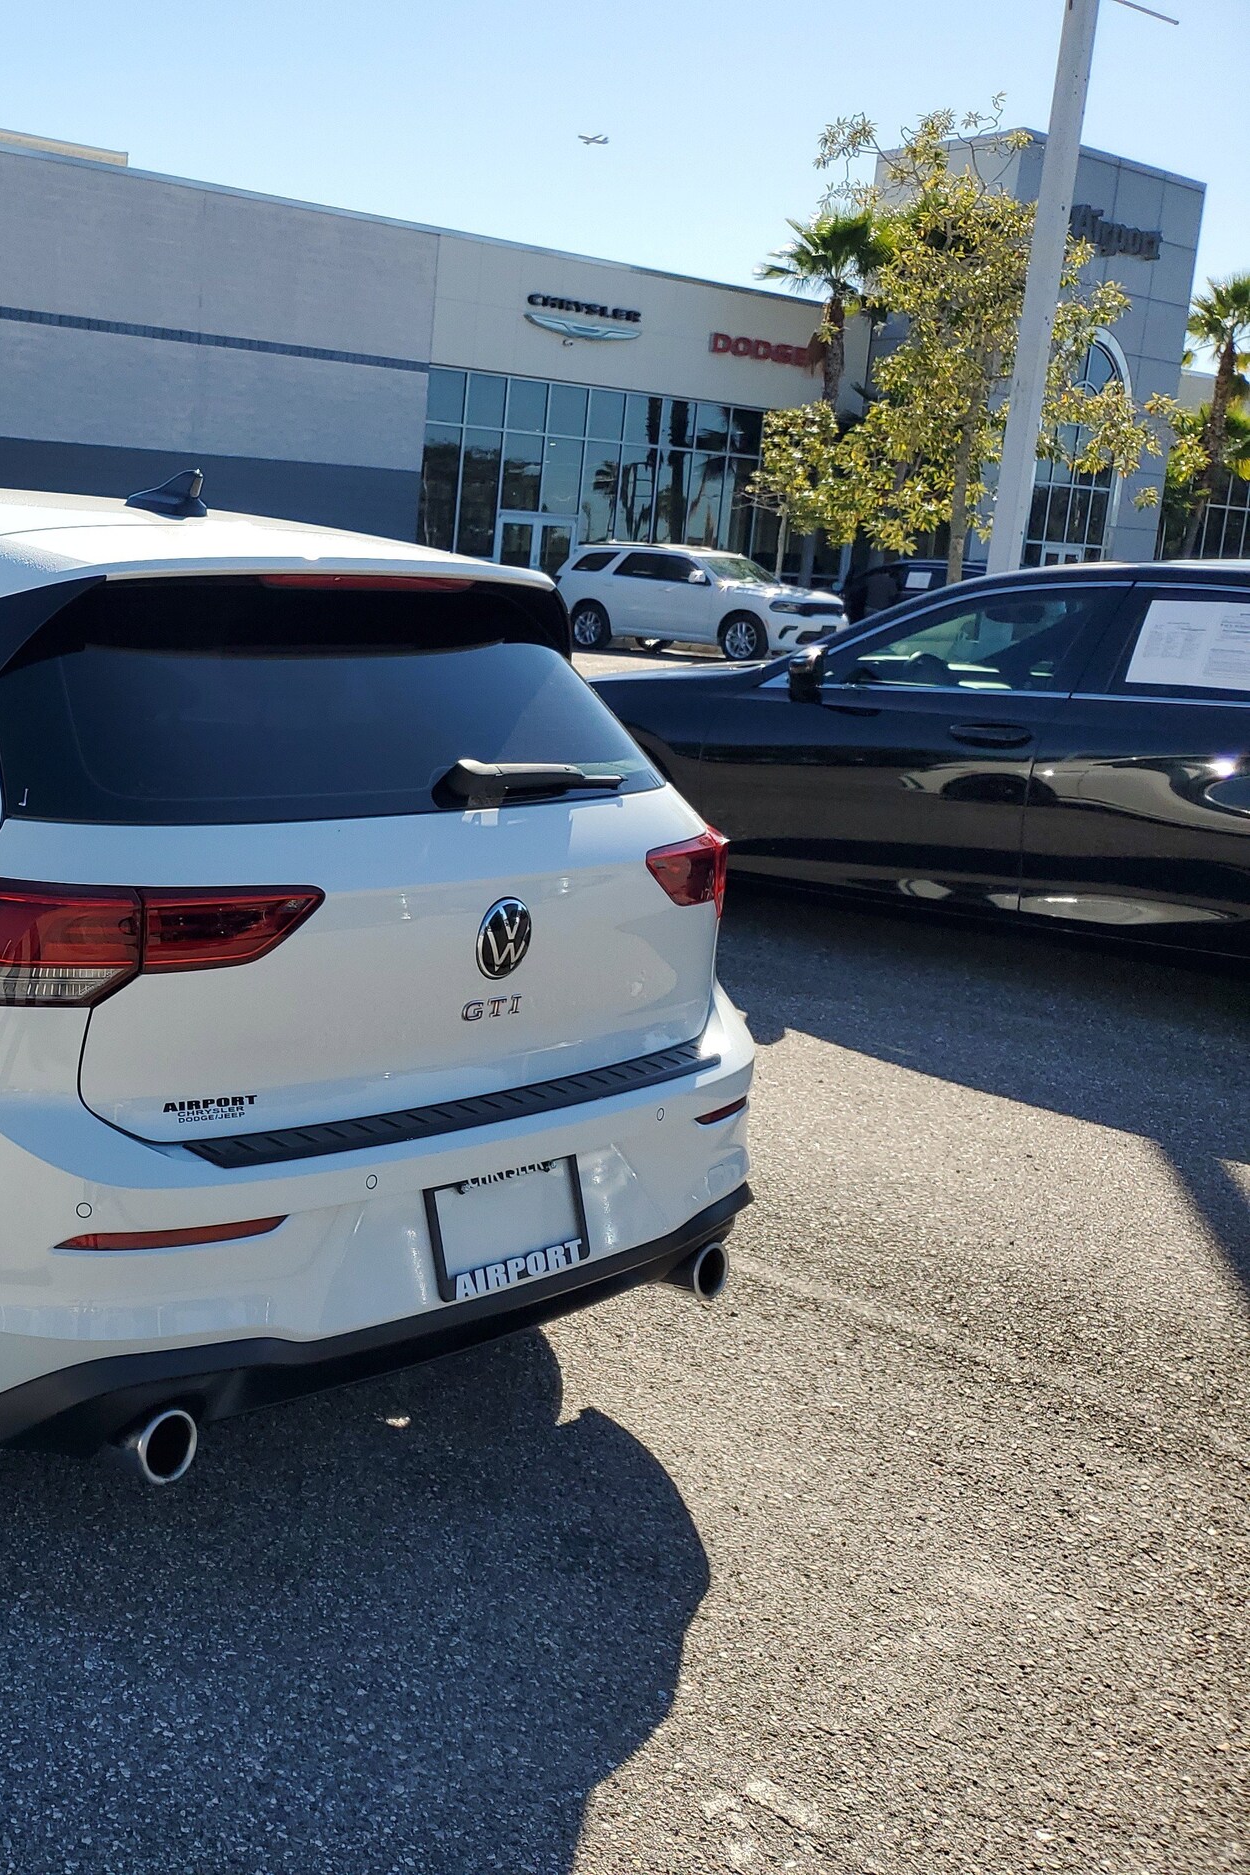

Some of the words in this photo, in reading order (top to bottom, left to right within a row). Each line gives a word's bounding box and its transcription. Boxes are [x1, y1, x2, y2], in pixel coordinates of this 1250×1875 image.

[527, 293, 642, 323] CHRYSLER
[709, 332, 811, 368] DODGE
[461, 993, 523, 1021] GTI
[162, 1094, 258, 1113] AIRPORT
[177, 1105, 245, 1118] CHRYSLER
[178, 1111, 246, 1124] DODGE/JEEP
[454, 1238, 583, 1301] AIRPORT
